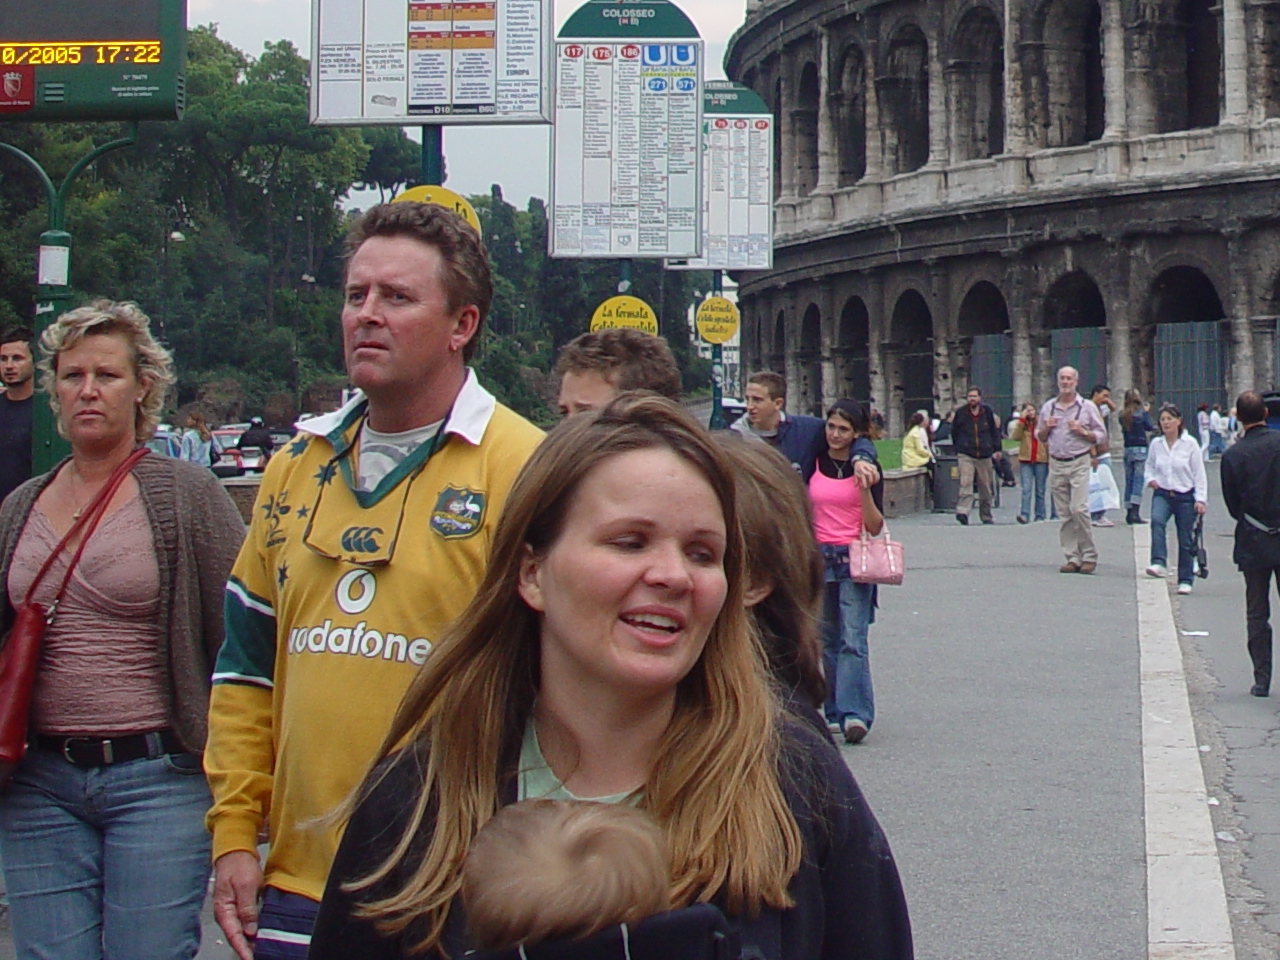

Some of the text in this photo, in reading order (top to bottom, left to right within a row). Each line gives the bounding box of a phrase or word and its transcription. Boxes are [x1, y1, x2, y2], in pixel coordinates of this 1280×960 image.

[602, 9, 656, 18] COLOSSEO
[96, 45, 161, 64] 17:22
[565, 48, 581, 56] 117
[650, 80, 666, 88] 271
[678, 80, 694, 88] 571
[602, 305, 648, 319] La fermata
[288, 618, 433, 667] vodafone
